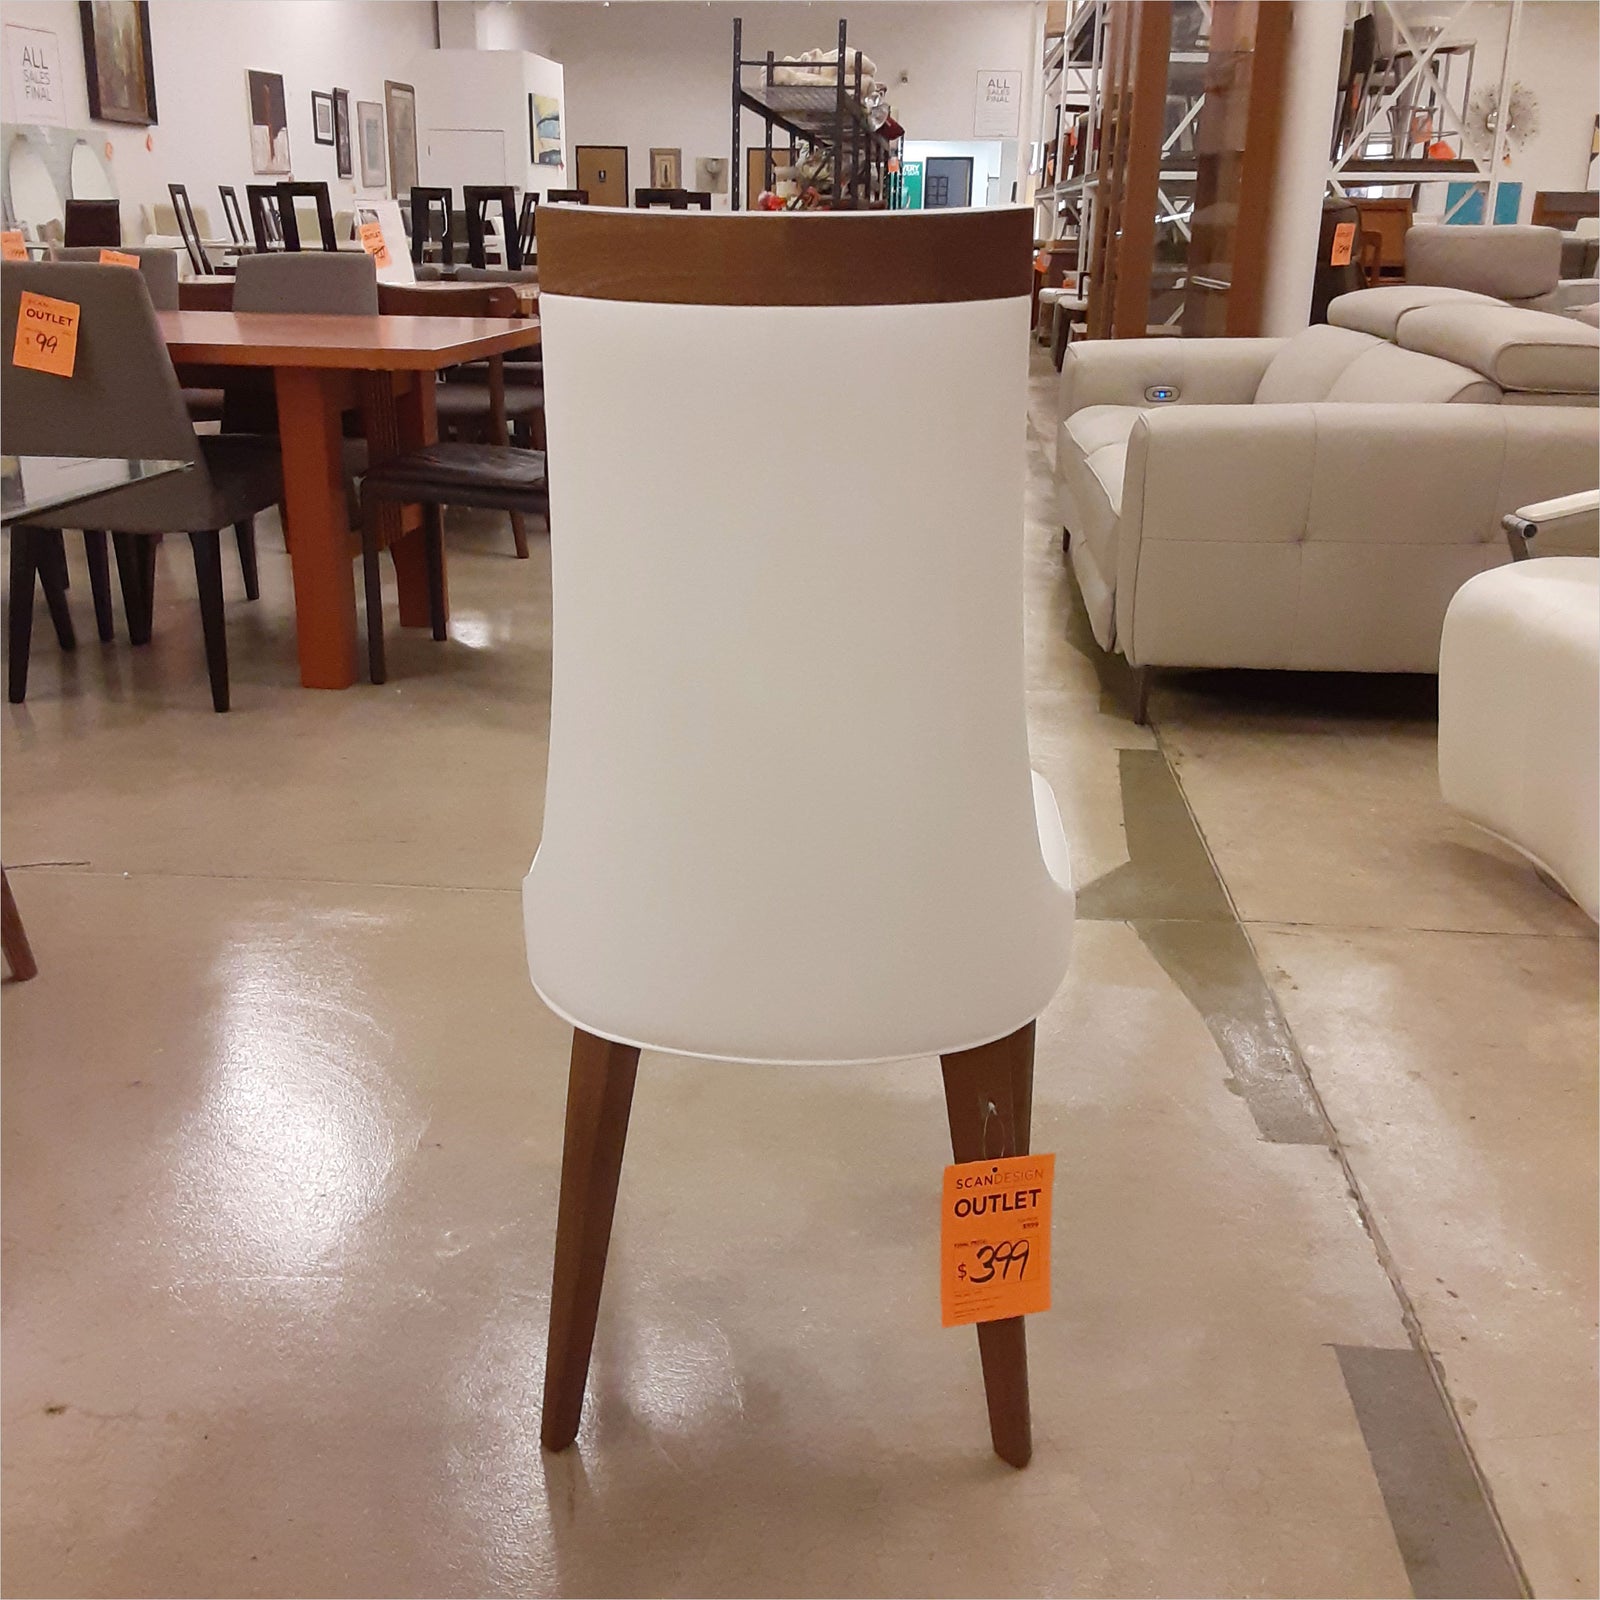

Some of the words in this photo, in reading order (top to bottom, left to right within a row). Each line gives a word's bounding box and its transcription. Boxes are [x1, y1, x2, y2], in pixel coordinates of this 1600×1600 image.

[22, 46, 49, 70] ALL
[23, 69, 51, 86] SALES
[987, 79, 1010, 89] ALL
[25, 85, 53, 102] FINAL
[26, 308, 73, 327] OUTLET
[36, 333, 58, 354] 99
[954, 1189, 1042, 1218] OUTLET
